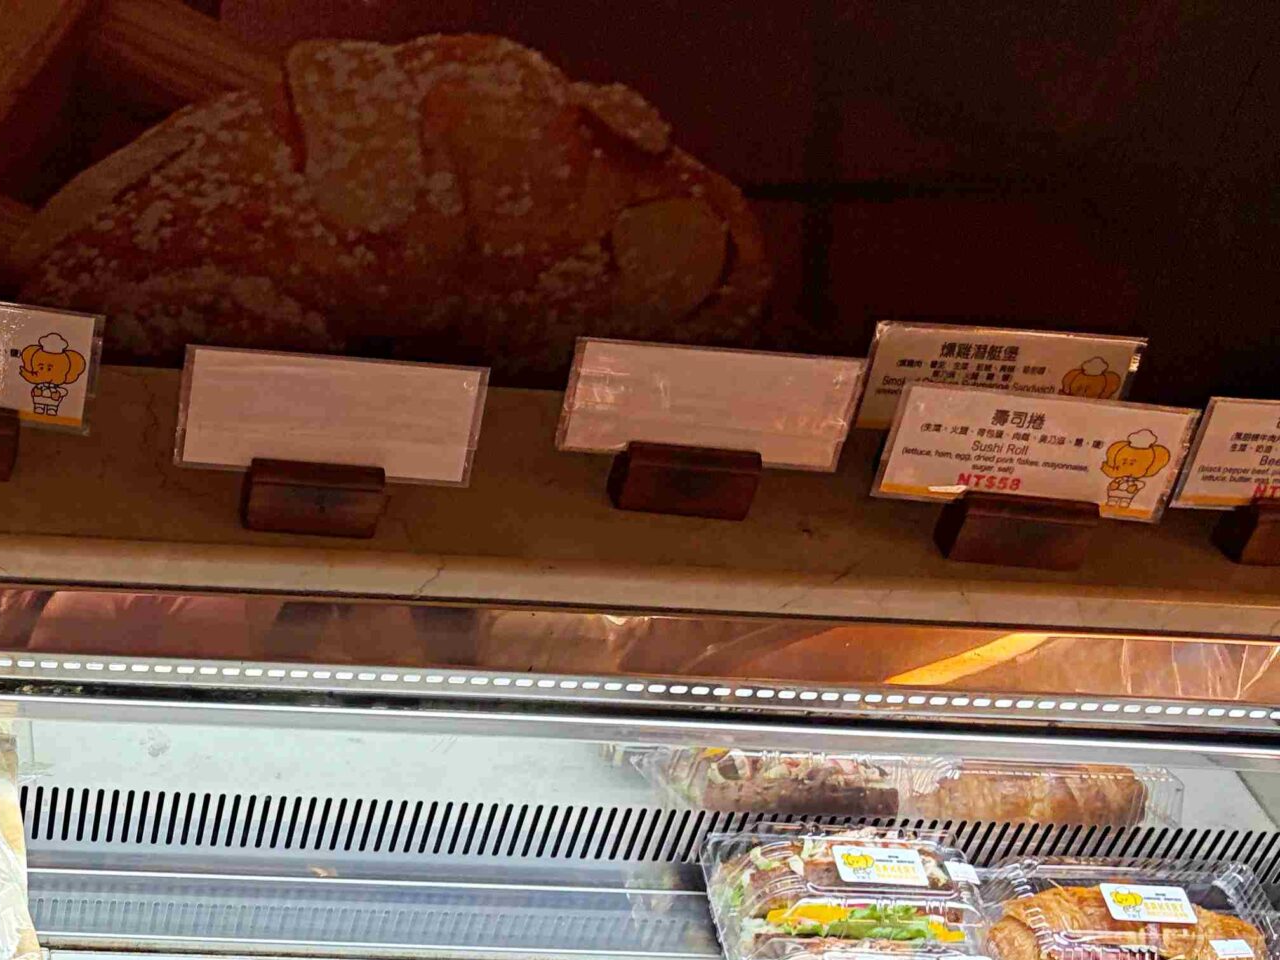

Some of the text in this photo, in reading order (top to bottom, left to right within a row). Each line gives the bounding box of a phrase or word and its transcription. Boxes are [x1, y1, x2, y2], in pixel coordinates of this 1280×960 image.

[991, 409, 1046, 431] 壽司捲
[971, 440, 1030, 456] Sushi Roll
[957, 473, 1022, 491] NT$58
